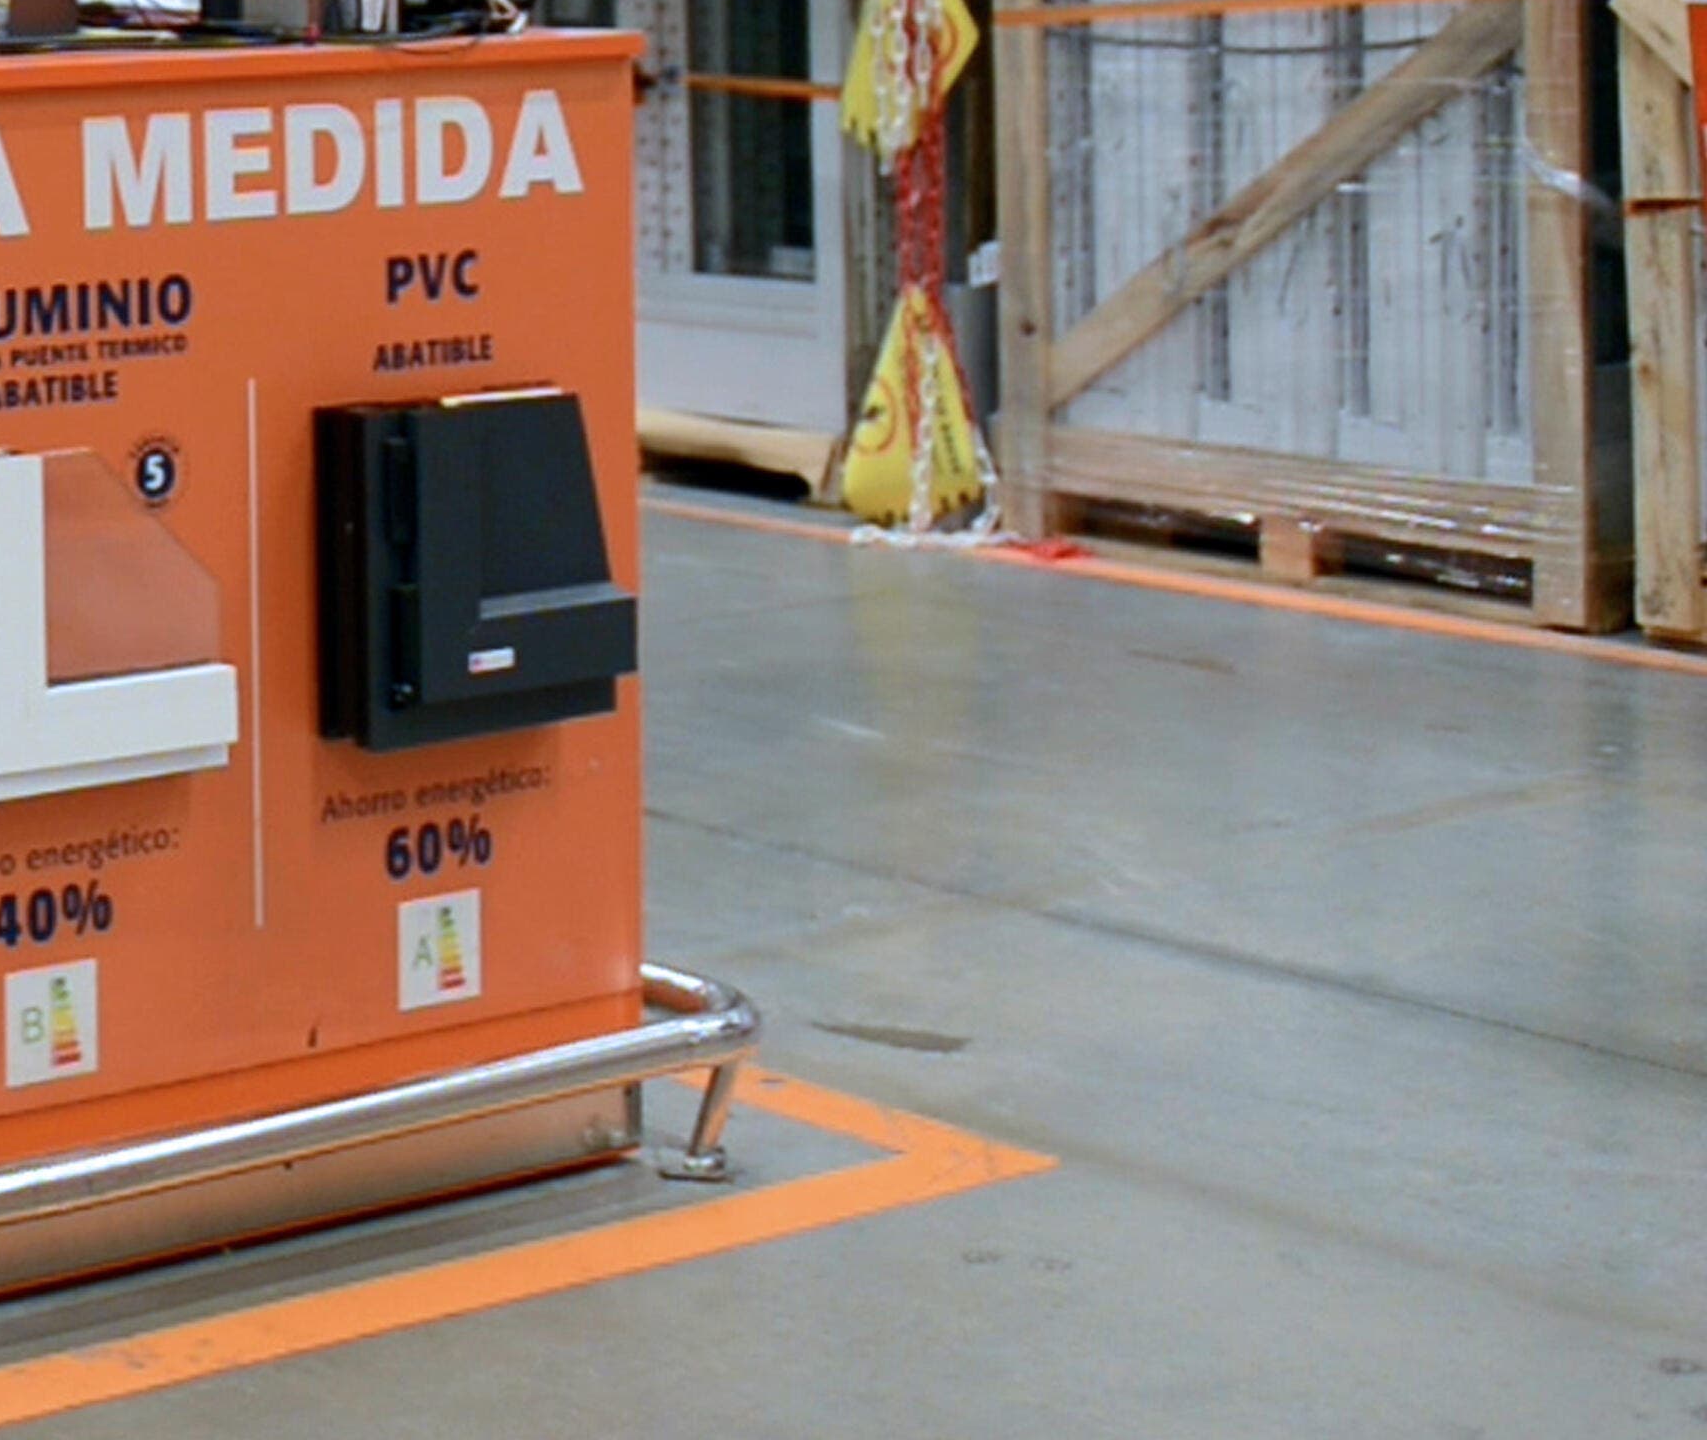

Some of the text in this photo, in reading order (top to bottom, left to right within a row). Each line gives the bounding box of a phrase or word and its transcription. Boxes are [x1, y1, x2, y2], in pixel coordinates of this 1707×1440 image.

[82, 89, 584, 230] MEDIDA
[386, 249, 479, 304] PVC
[10, 342, 93, 369] PUENTE
[372, 334, 493, 373] ABATIBLE
[144, 454, 167, 490] 5
[319, 763, 552, 823] Ahorro energético:
[25, 826, 181, 874] energético:
[385, 816, 492, 881] 60%
[411, 933, 433, 970] A
[21, 1006, 45, 1044] B
